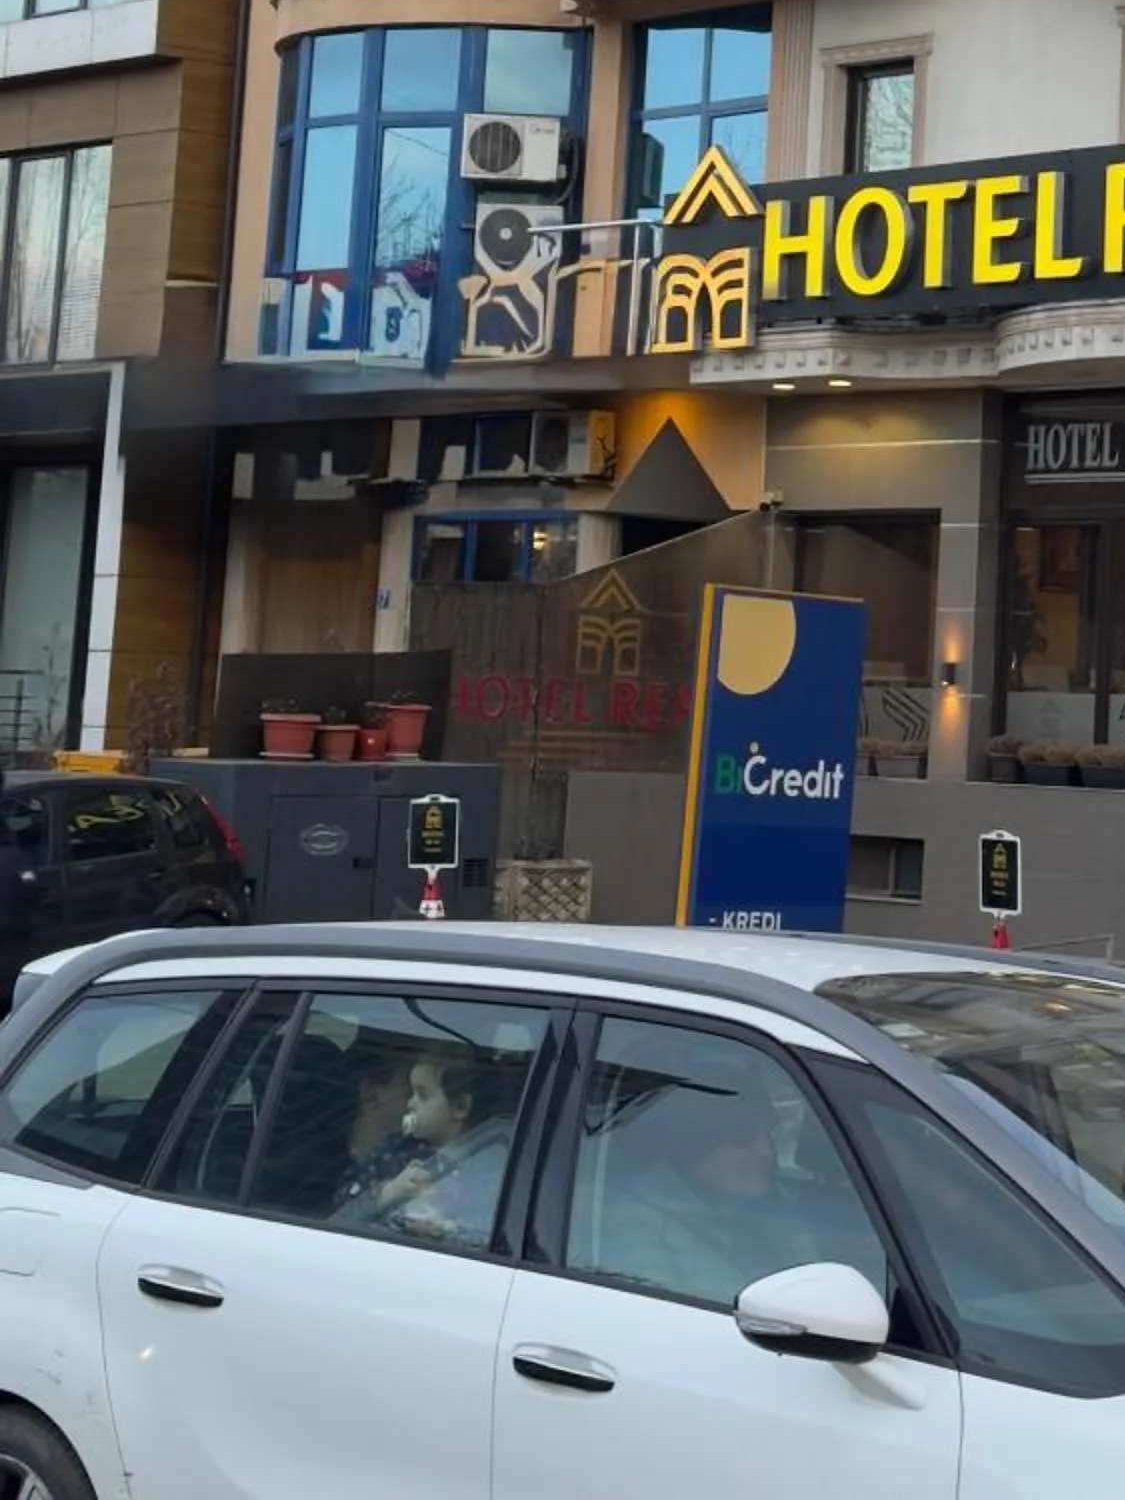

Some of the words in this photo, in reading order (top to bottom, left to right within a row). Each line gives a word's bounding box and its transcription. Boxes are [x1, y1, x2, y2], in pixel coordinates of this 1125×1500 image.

[762, 170, 1085, 299] HOTEL
[1026, 412, 1119, 470] HOTEL
[715, 741, 845, 799] BiCredit
[722, 910, 782, 932] KREDI
